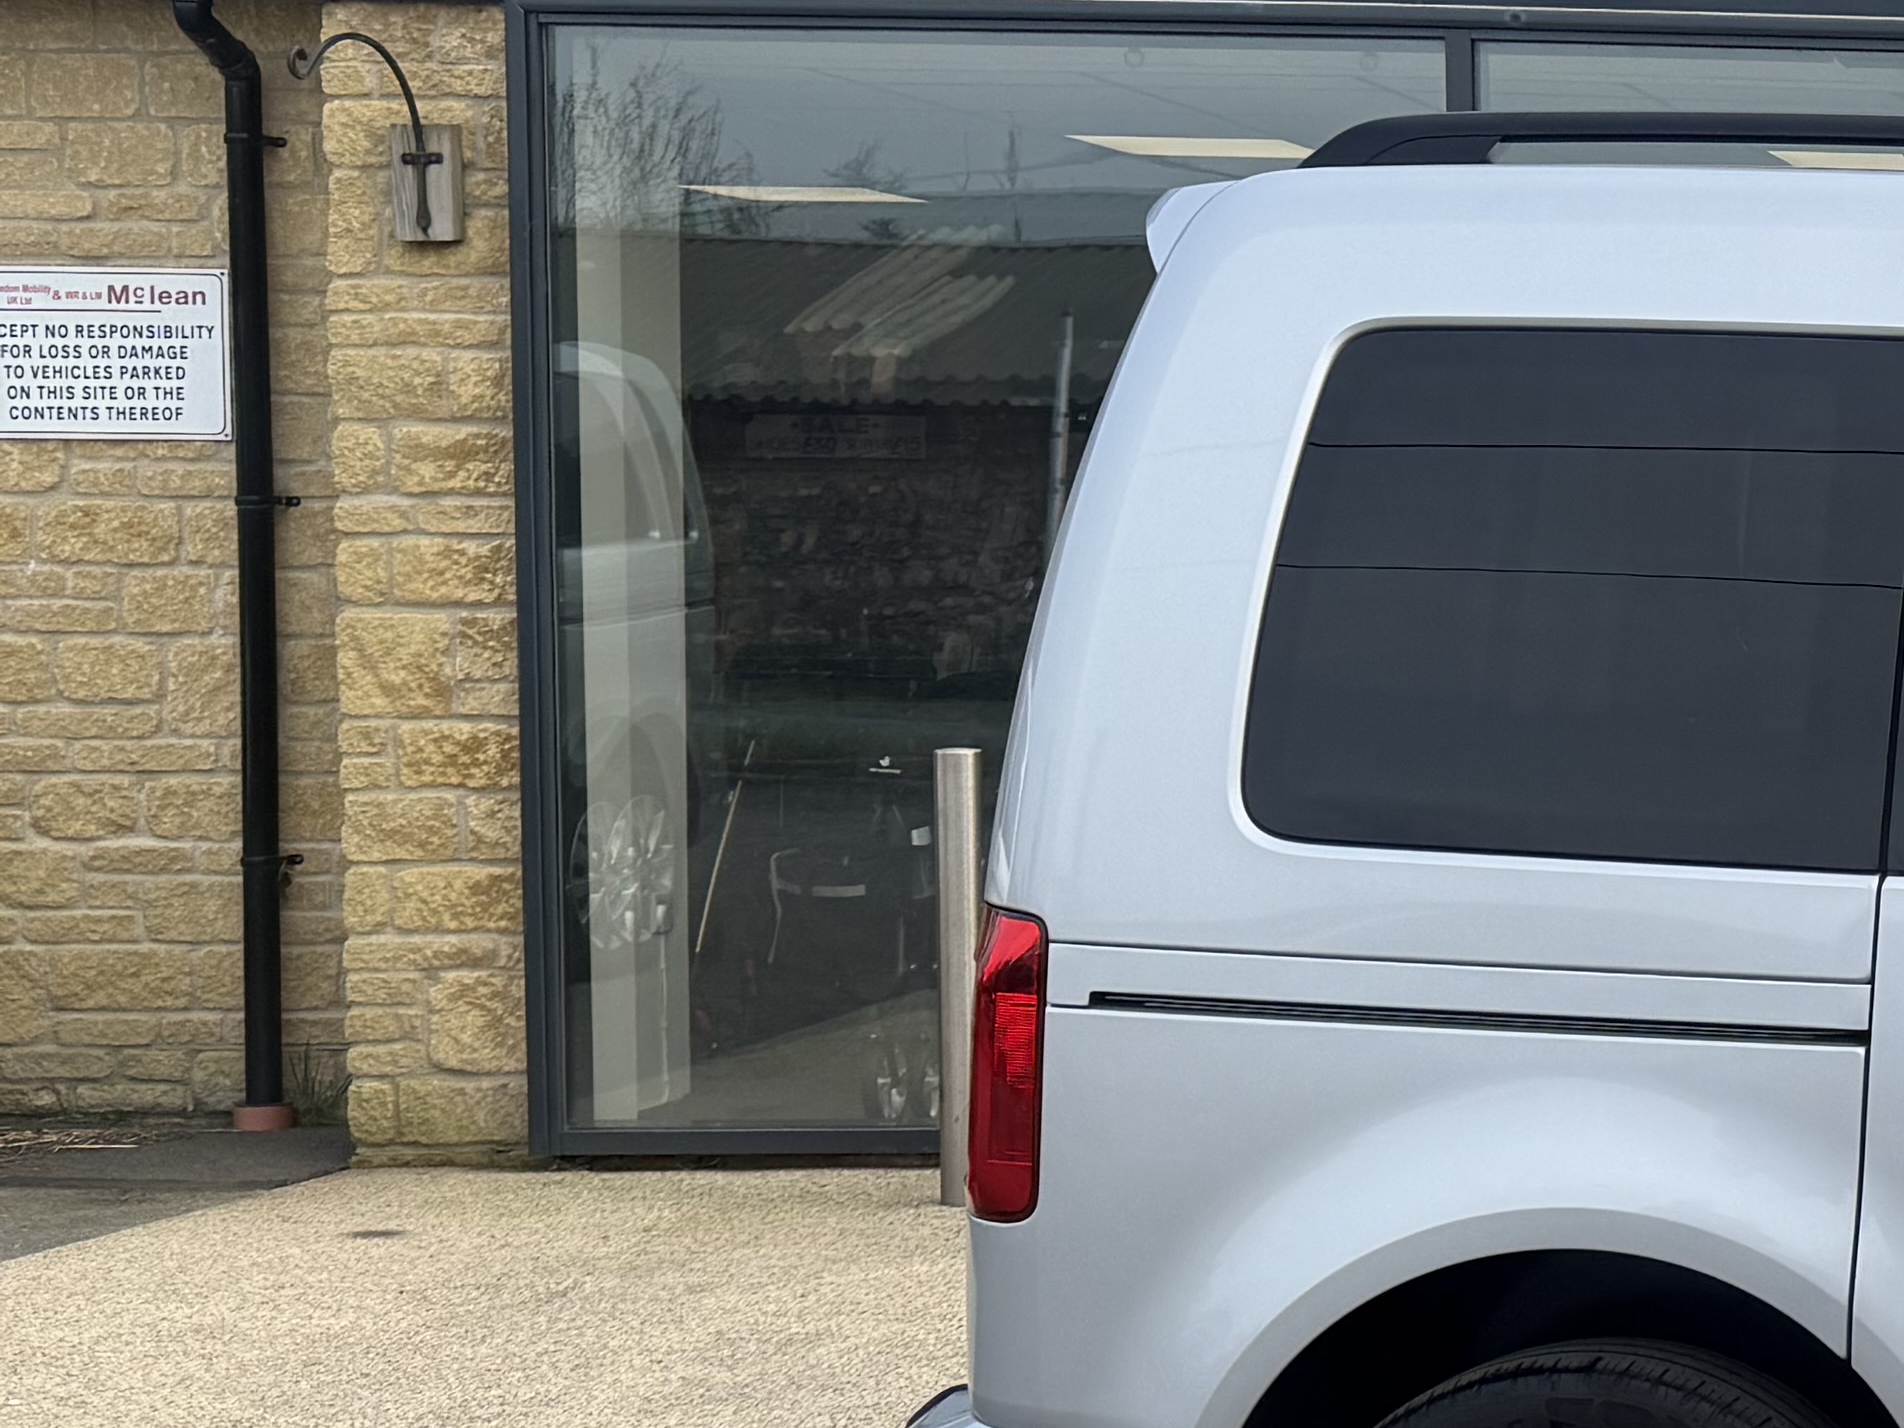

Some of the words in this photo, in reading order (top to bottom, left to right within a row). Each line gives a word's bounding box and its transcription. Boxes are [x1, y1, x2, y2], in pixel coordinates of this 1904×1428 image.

[52, 289, 62, 301] &
[44, 324, 69, 339] NO
[74, 324, 215, 340] RESPONSIBILITY
[0, 344, 32, 359] FOR
[39, 344, 82, 359] LOSS
[88, 344, 111, 359] OR
[117, 345, 189, 360] DAMAGE
[3, 365, 25, 380] TO
[30, 365, 113, 380] VEHICLES
[119, 366, 186, 381] PARKED
[6, 385, 31, 400] ON
[37, 385, 75, 400] THIS
[81, 386, 118, 401] SITE
[124, 386, 147, 401] OR
[152, 386, 185, 401] THE
[9, 405, 100, 421] CONTENTS
[105, 406, 183, 421] THEREOF
